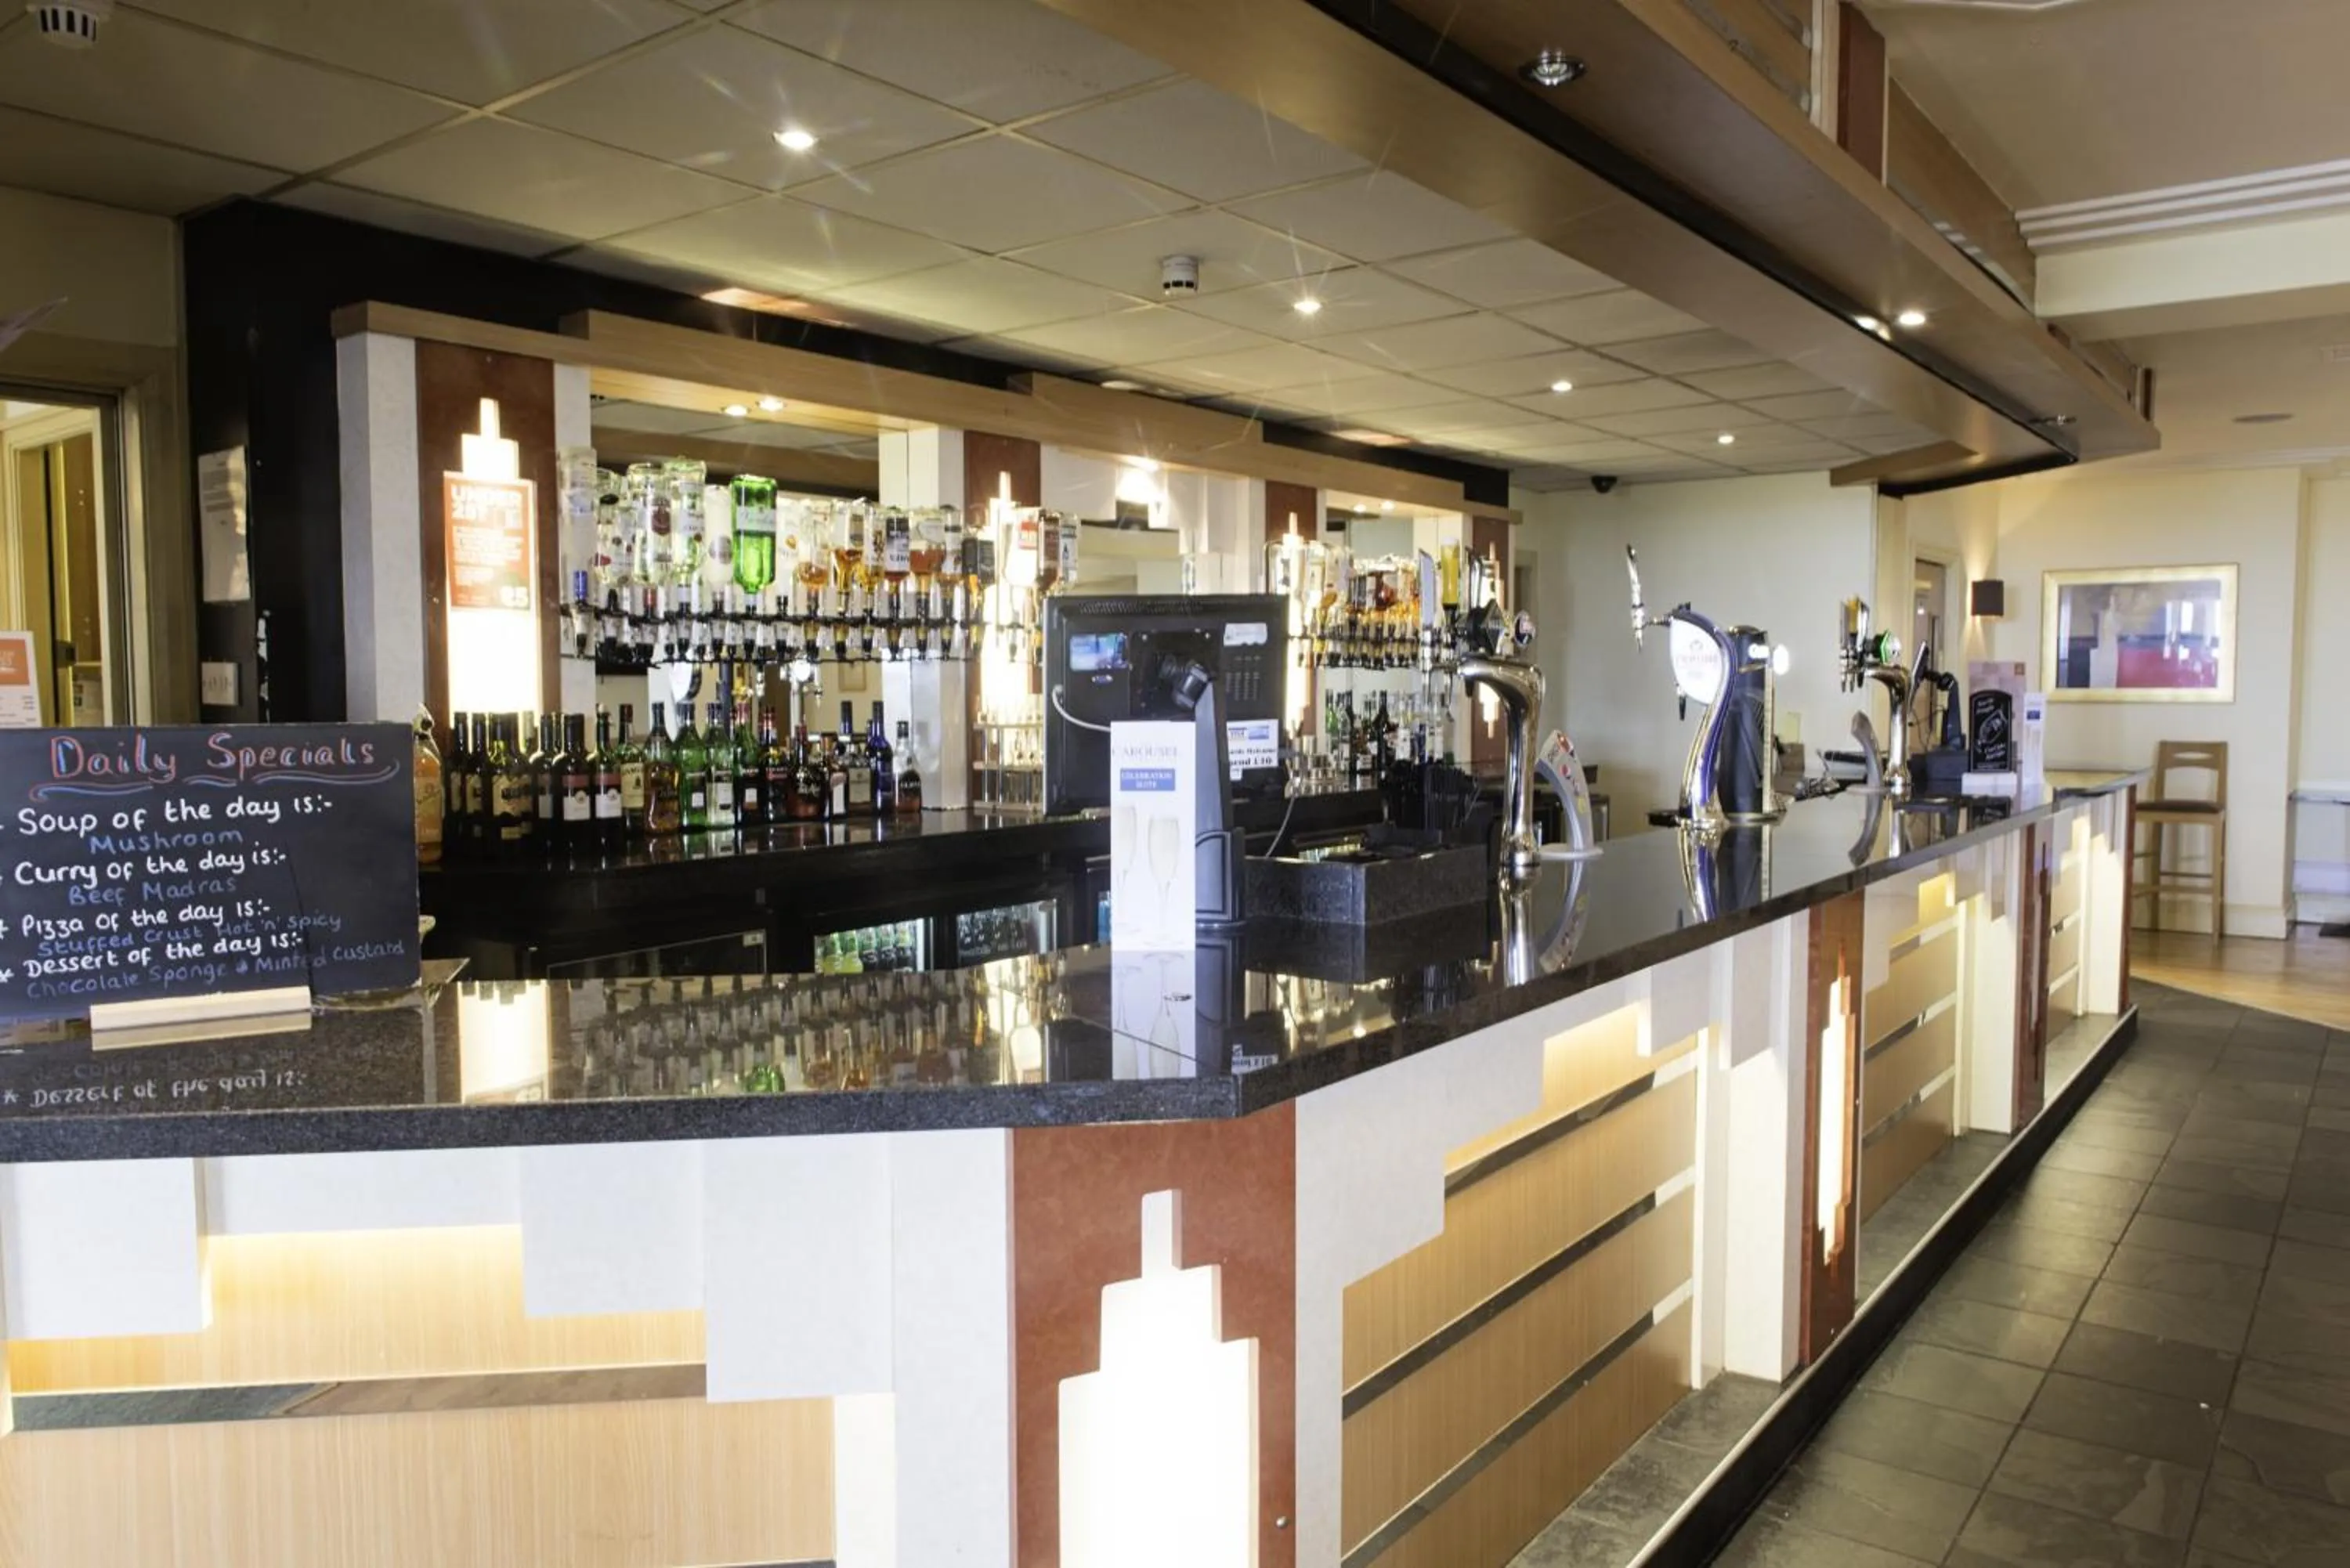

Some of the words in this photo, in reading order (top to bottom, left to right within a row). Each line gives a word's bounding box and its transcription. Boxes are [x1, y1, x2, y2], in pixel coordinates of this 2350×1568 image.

[50, 732, 176, 783] Daily
[207, 732, 374, 781] Specials
[17, 807, 98, 838] Soup
[112, 808, 147, 832] of
[164, 797, 212, 822] the
[226, 795, 280, 823] day
[89, 829, 244, 854] Mushroom
[14, 861, 98, 889] Curry
[146, 855, 189, 875] the
[199, 850, 245, 874] day
[69, 884, 126, 907] Beef
[143, 877, 237, 902] Madras
[21, 914, 85, 940] Pizza
[130, 909, 169, 928] the
[178, 904, 224, 927] day
[38, 933, 135, 957] Stuffed
[143, 927, 204, 941] Crust
[217, 920, 255, 938] Hot
[23, 949, 120, 978] Dessert
[127, 947, 152, 967] of
[165, 941, 205, 959] the
[213, 934, 262, 956] day
[27, 973, 140, 999] Chocolate
[149, 963, 228, 988] Sponge
